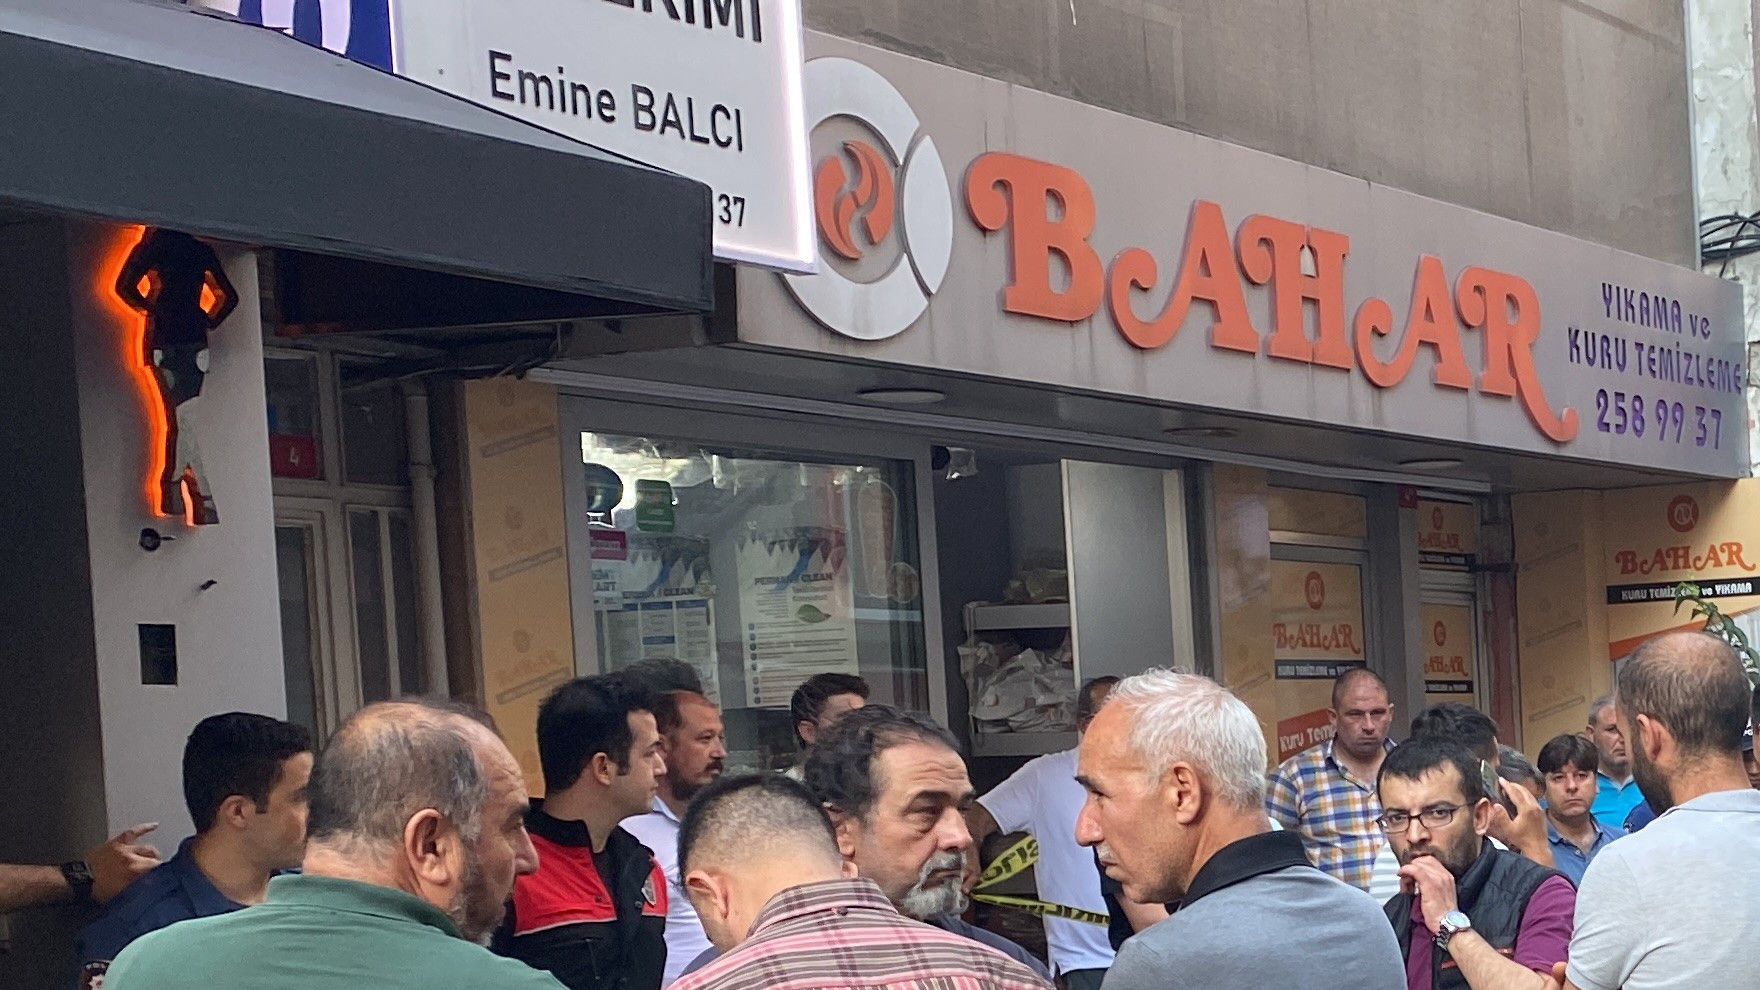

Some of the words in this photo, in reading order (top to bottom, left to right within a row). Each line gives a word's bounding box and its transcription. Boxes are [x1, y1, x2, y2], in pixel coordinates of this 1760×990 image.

[489, 50, 616, 122] Emine
[632, 84, 743, 151] BALCI
[718, 193, 745, 226] 37
[963, 151, 1579, 443] BAHAR
[1602, 283, 1682, 333] YIKAMA
[1689, 314, 1711, 339] ve
[1568, 327, 1627, 373] KURU
[1635, 341, 1742, 394] TEMİZLEME
[1596, 388, 1646, 438] 258
[1655, 399, 1685, 443] 99
[1695, 406, 1722, 450] 37
[1615, 542, 1756, 575] BAHAR
[1621, 588, 1648, 601] KURU
[1715, 583, 1752, 595] YIKAMA
[1273, 623, 1361, 655] BAHAR
